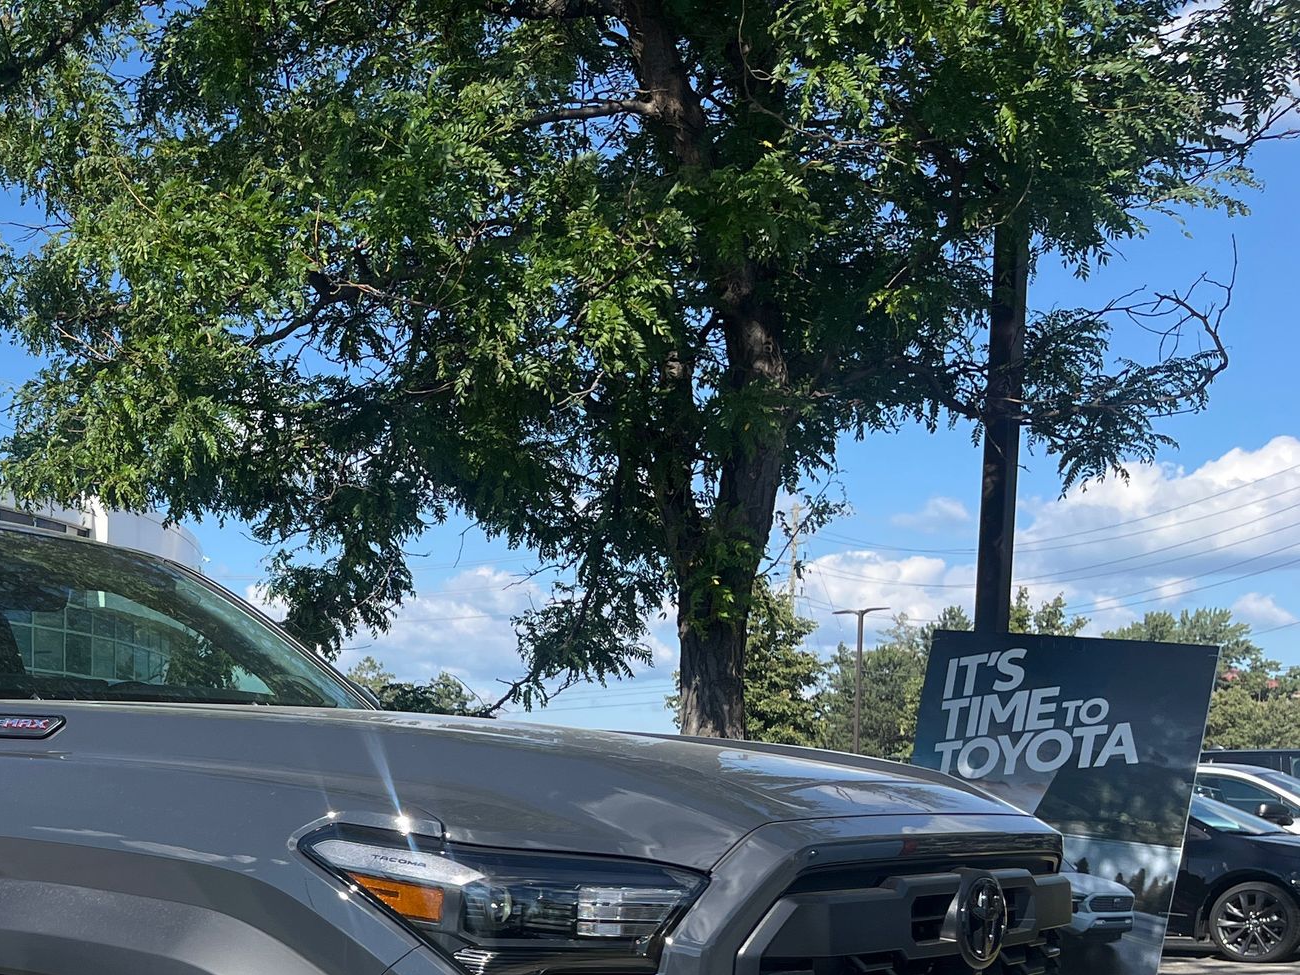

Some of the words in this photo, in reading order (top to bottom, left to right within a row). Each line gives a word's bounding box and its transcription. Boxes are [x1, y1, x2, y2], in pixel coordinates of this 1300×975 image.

[943, 648, 1027, 699] IT'S
[941, 686, 1060, 740] TIME
[1062, 697, 1110, 727] TO
[934, 722, 1139, 780] TOYOTA
[372, 854, 427, 868] TACOMA
